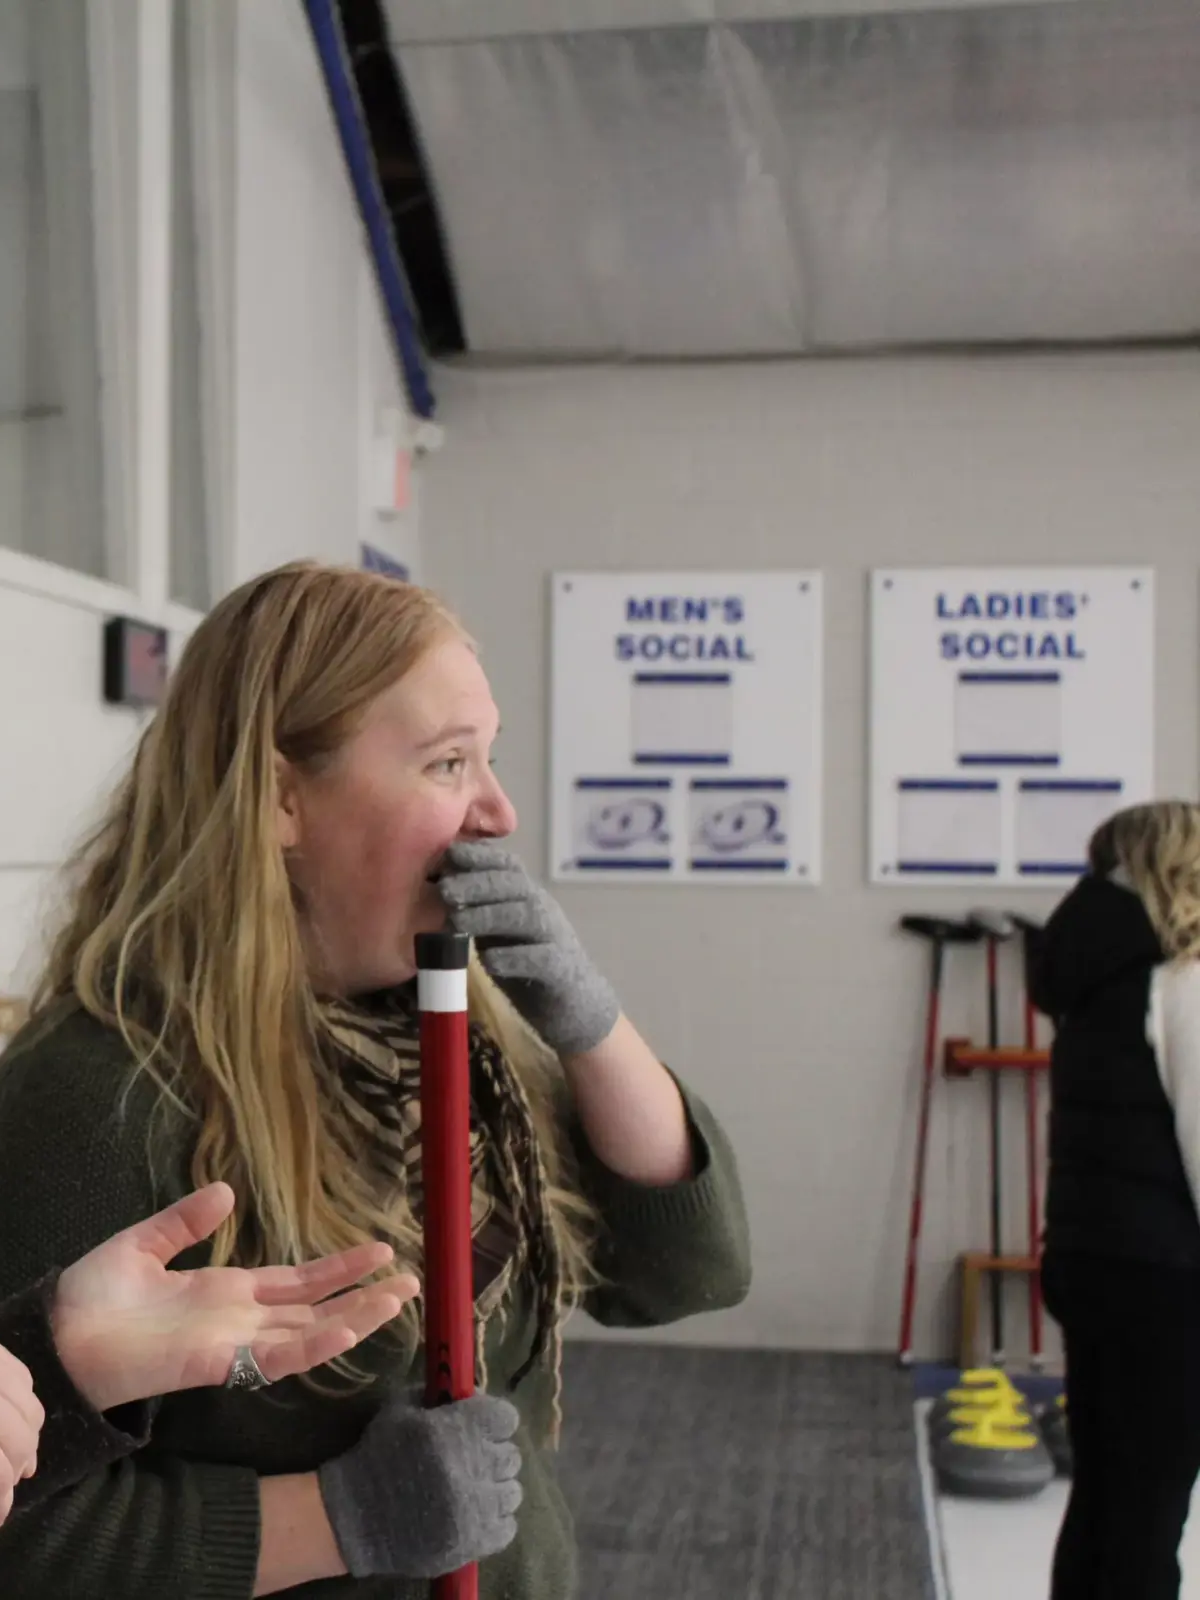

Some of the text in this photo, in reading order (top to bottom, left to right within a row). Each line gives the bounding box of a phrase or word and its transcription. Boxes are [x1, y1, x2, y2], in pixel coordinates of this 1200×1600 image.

[626, 597, 744, 623] MEN'S
[936, 593, 1088, 619] LADIES'
[615, 634, 754, 662] SOCIAL
[940, 632, 1085, 660] SOCIAL
